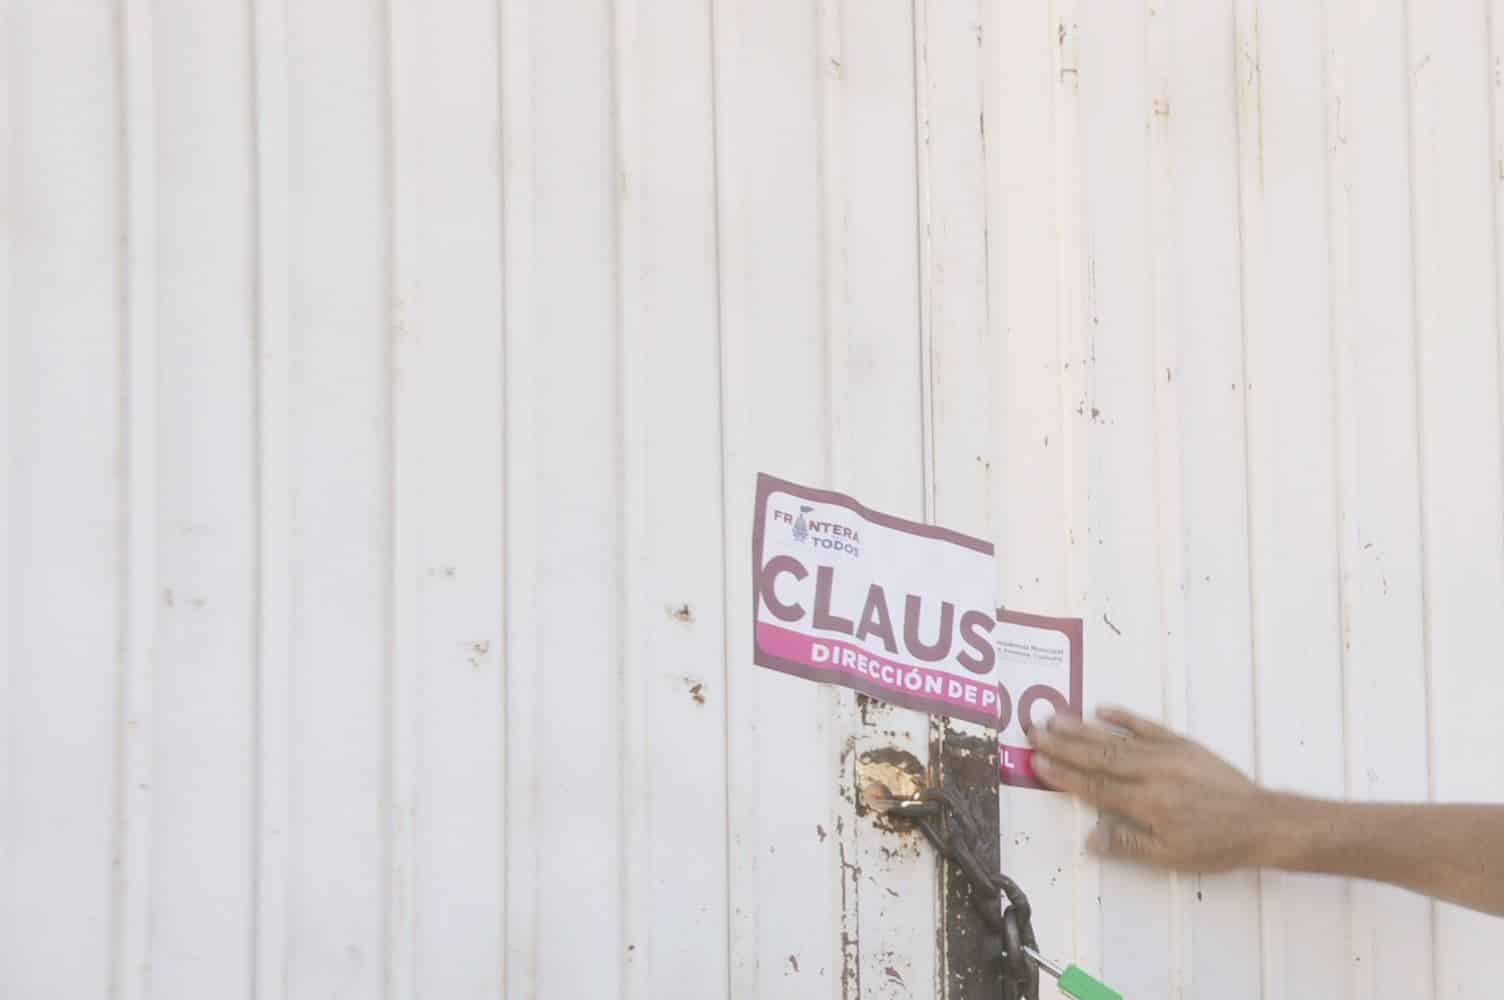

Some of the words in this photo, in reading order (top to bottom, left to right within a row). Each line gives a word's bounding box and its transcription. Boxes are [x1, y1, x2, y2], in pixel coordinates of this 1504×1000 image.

[774, 507, 860, 543] FRNTERA
[811, 642, 943, 695] DIRECCIÓN
[948, 680, 977, 704] DE
